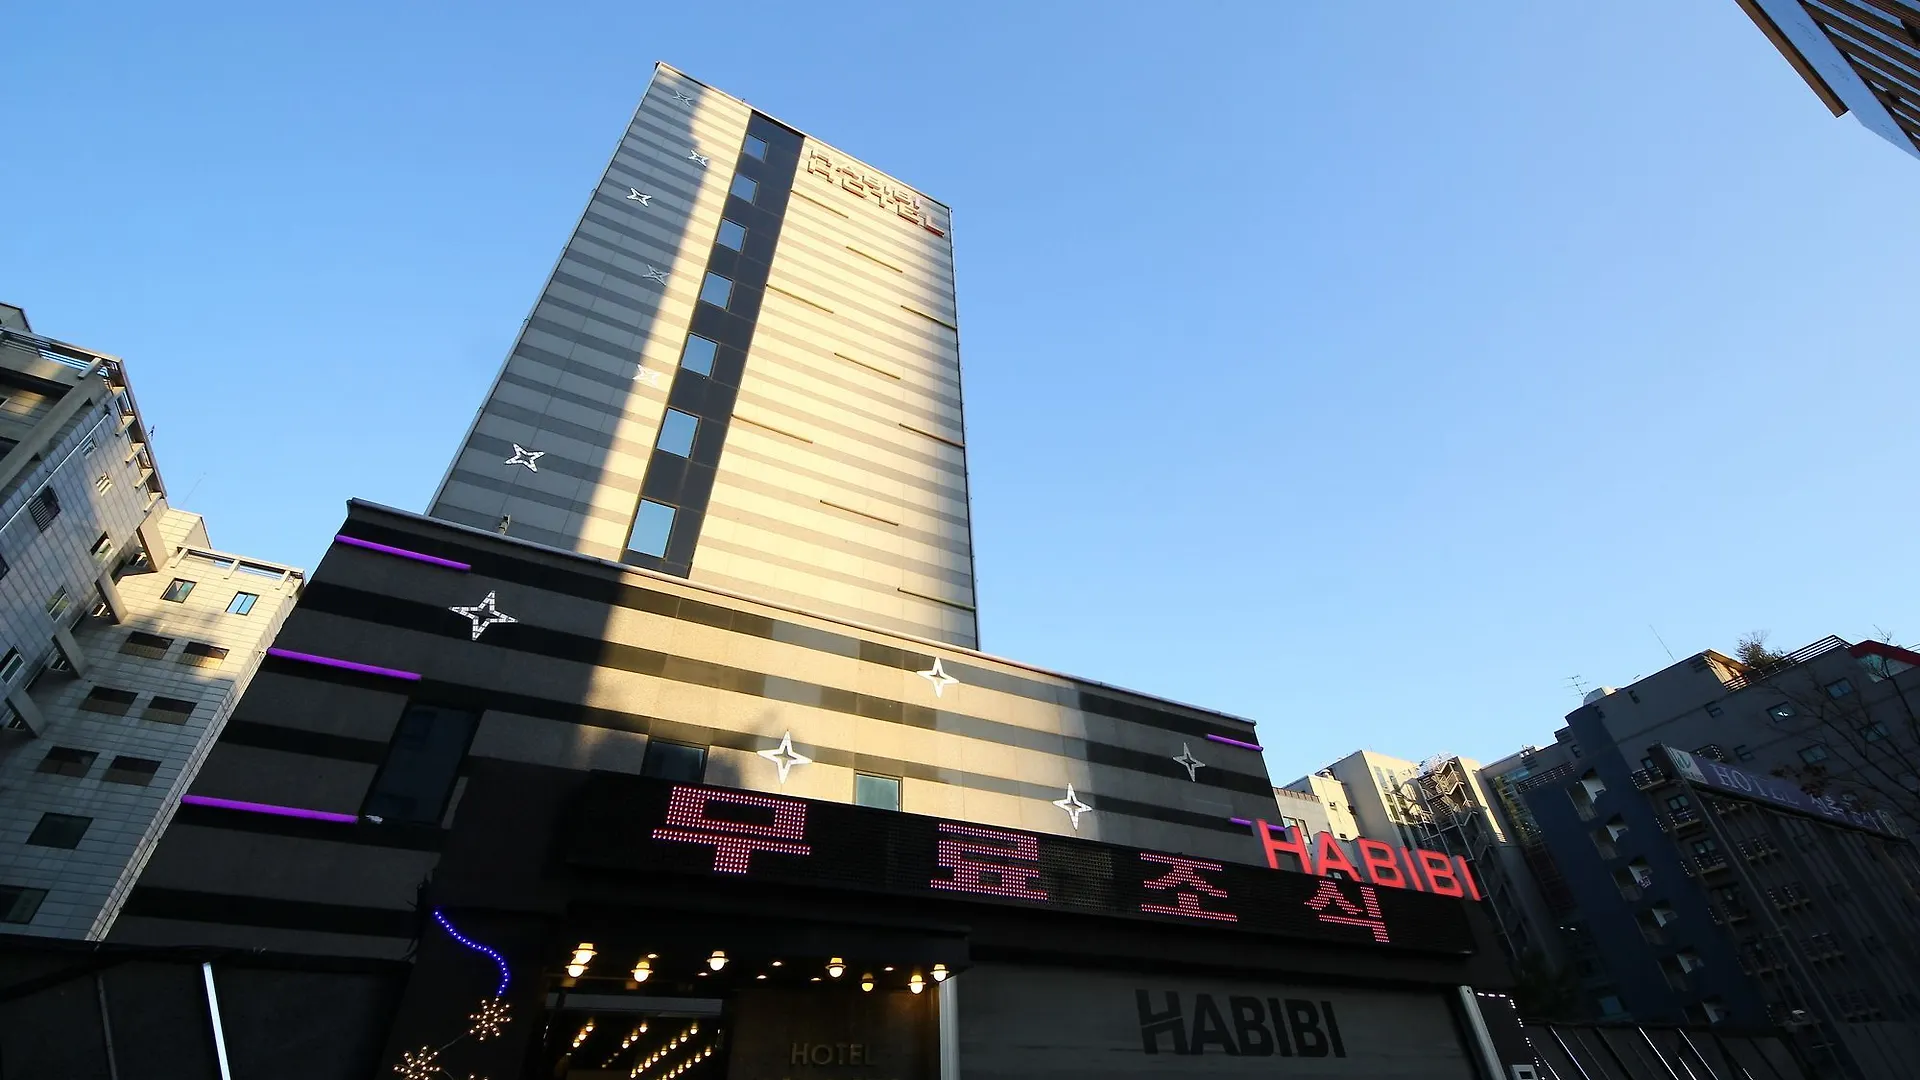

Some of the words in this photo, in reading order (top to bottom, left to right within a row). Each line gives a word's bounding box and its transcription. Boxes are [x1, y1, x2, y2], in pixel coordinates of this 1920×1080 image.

[807, 159, 946, 239] HOTEL
[1255, 818, 1482, 901] HABIBI
[791, 1041, 877, 1066] HOTEL
[1135, 988, 1347, 1059] HABIBI
